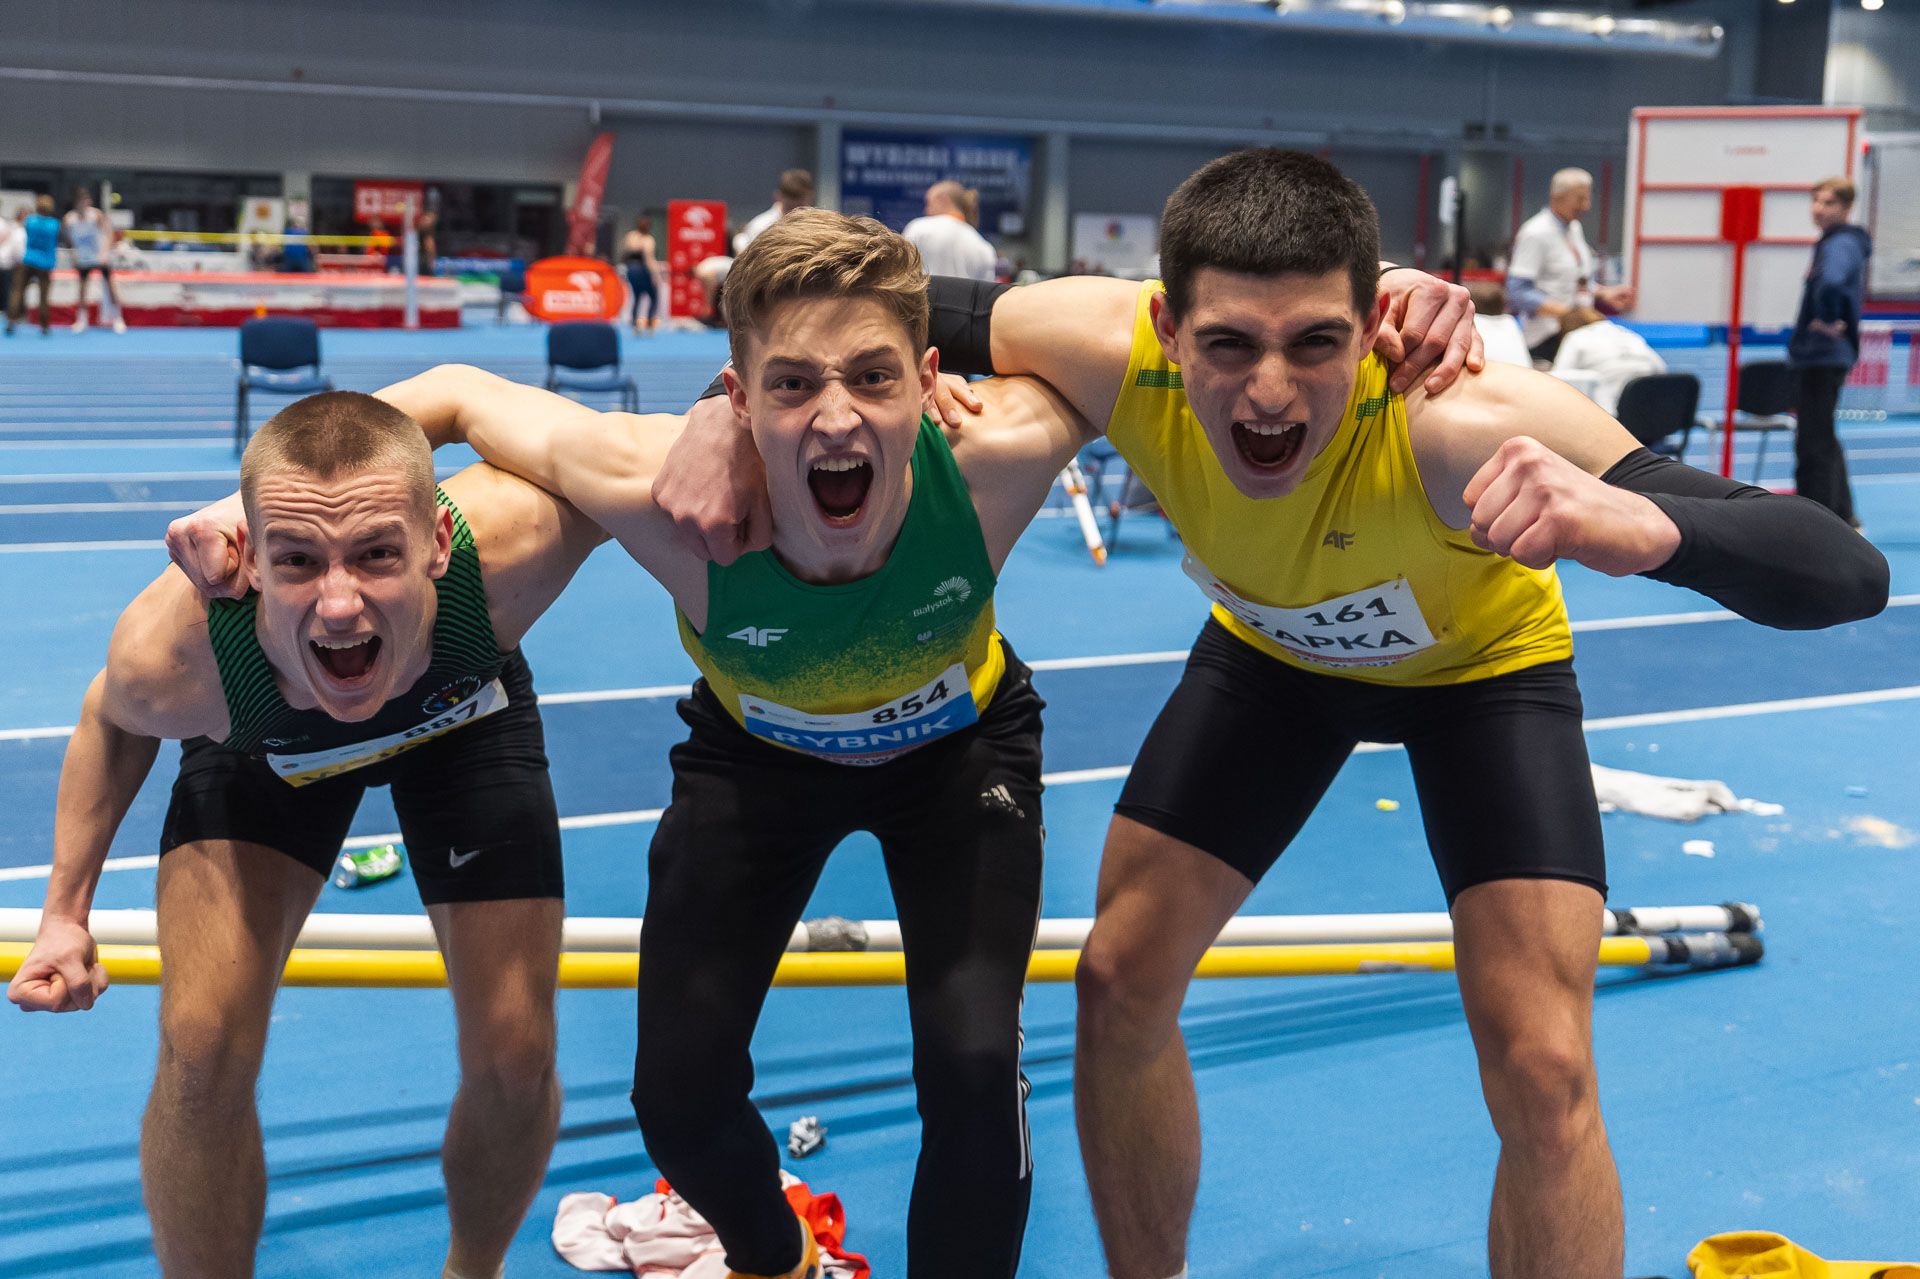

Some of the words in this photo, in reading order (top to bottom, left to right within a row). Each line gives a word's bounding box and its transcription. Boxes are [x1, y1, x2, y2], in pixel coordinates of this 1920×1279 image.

[1304, 596, 1397, 627] 161
[403, 699, 478, 739] 887
[872, 679, 950, 724] 854
[772, 716, 952, 749] RYBNIK
